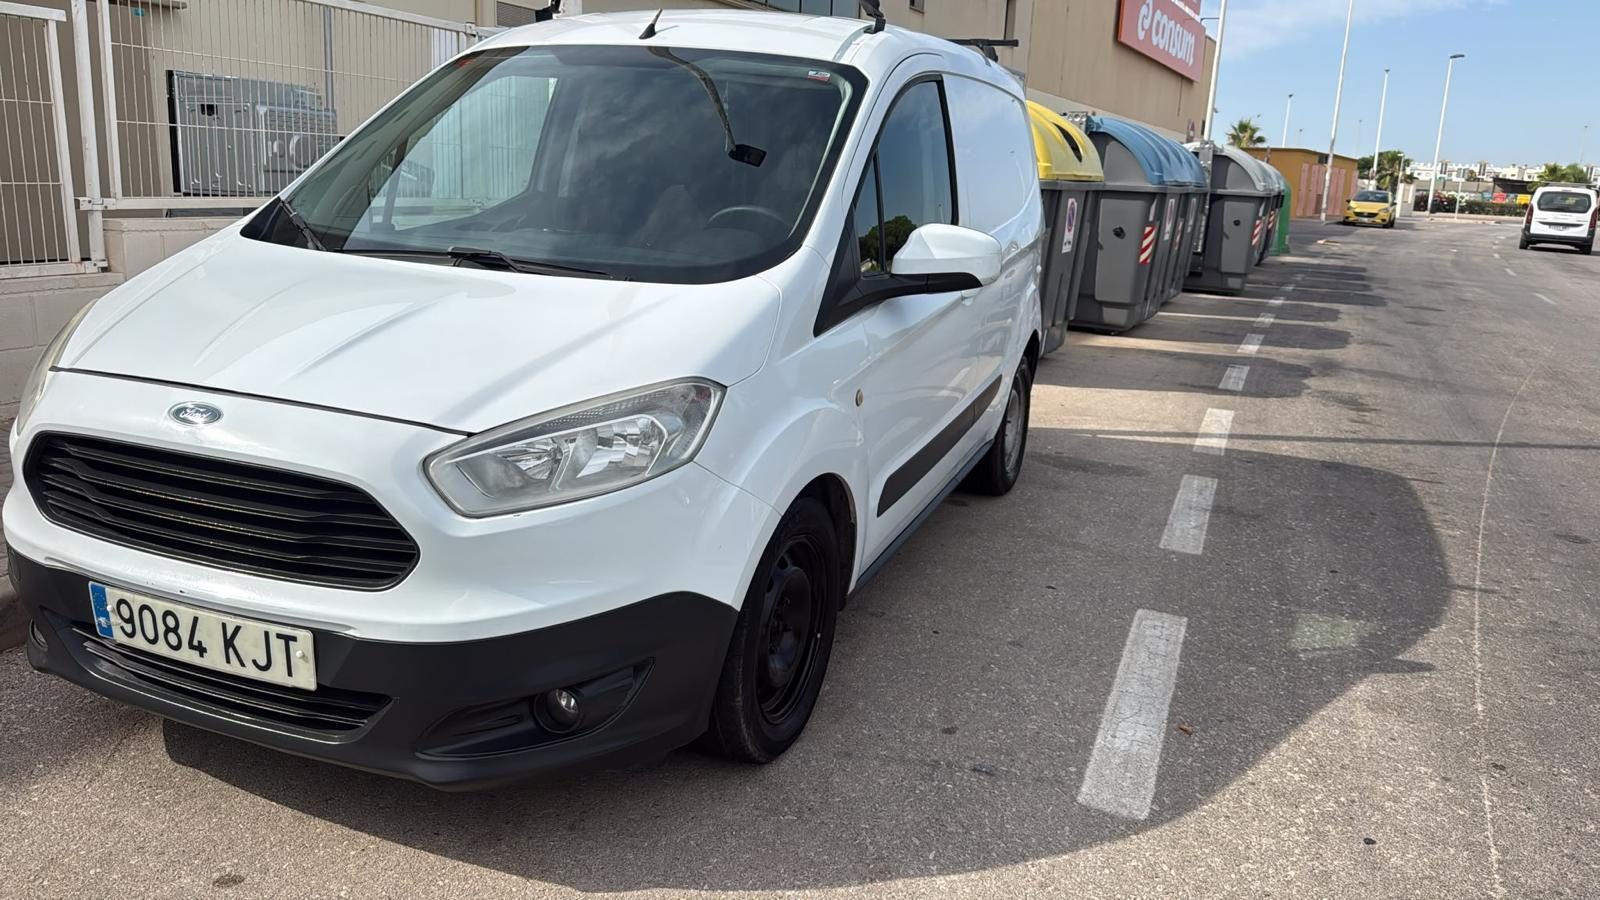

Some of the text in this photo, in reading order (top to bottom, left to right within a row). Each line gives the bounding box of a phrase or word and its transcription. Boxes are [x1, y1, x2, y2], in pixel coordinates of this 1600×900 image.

[1151, 10, 1195, 66] consum
[116, 598, 298, 677] 9084 KJT
